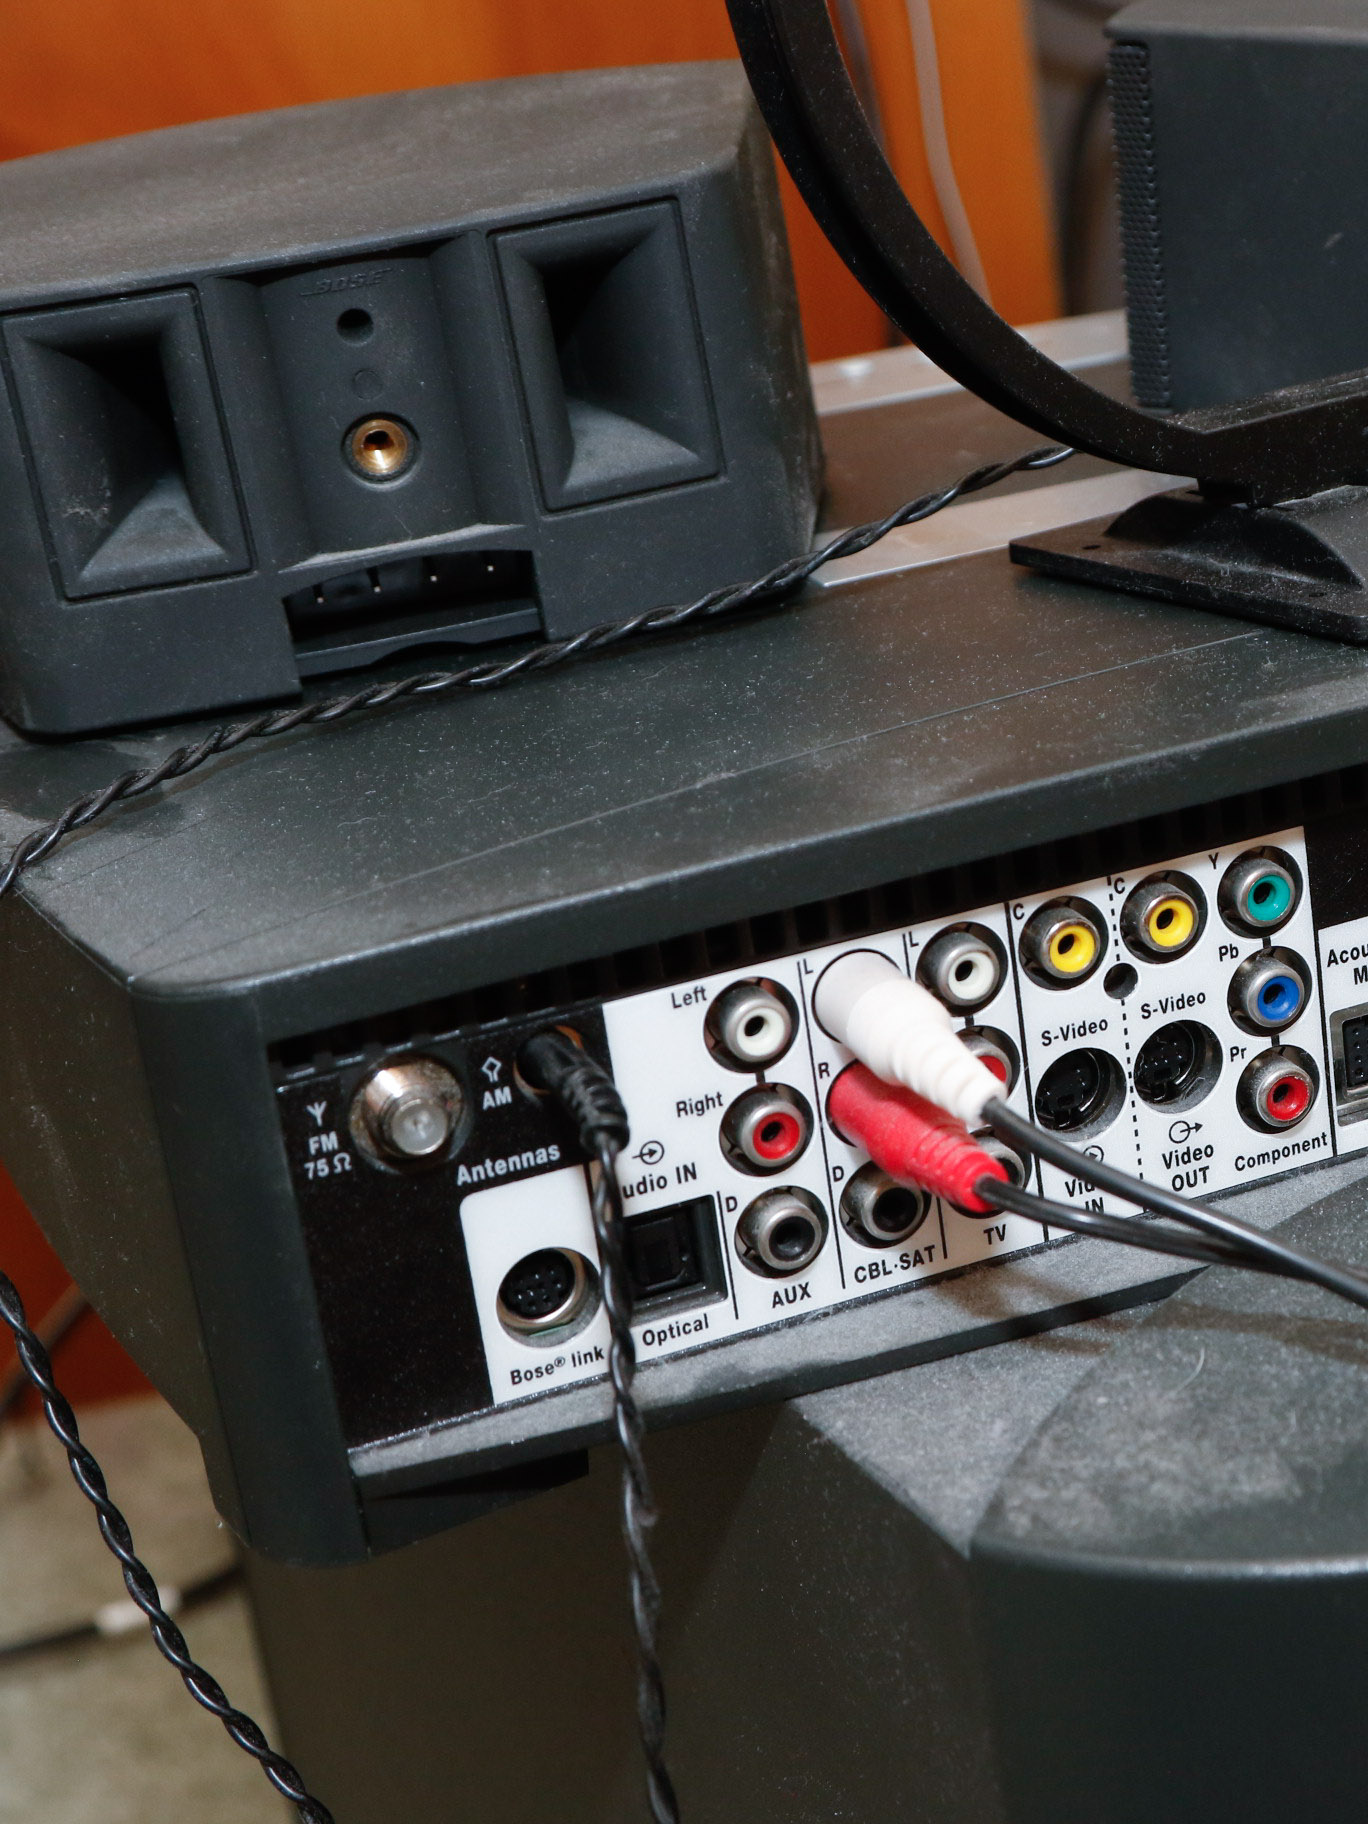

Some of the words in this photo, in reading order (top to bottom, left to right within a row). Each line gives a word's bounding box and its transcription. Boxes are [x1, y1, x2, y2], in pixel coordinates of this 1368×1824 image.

[1208, 853, 1219, 870] Y
[1113, 877, 1126, 895] C
[1013, 904, 1025, 921] C
[909, 930, 920, 947] L
[1218, 942, 1240, 962] Pb
[803, 958, 814, 975] L
[671, 986, 708, 1009] Left
[1140, 991, 1207, 1020] S-Video
[1040, 1017, 1109, 1047] S-Video
[1230, 1046, 1247, 1063] Pr
[818, 1062, 831, 1079] R
[482, 1086, 512, 1110] AM
[676, 1091, 724, 1118] Right
[309, 1132, 338, 1155] FM
[1234, 1131, 1329, 1172] Component
[456, 1144, 561, 1187] Antennas
[1161, 1144, 1215, 1171] Video
[304, 1161, 330, 1180] 75
[621, 1174, 667, 1198] udio
[676, 1162, 697, 1184] IN
[833, 1165, 845, 1182] D
[1171, 1166, 1211, 1192] OUT
[726, 1195, 738, 1213] D
[983, 1224, 1007, 1245] TV
[771, 1282, 812, 1309] AUX
[642, 1314, 709, 1347] Optical
[571, 1346, 604, 1368] link
